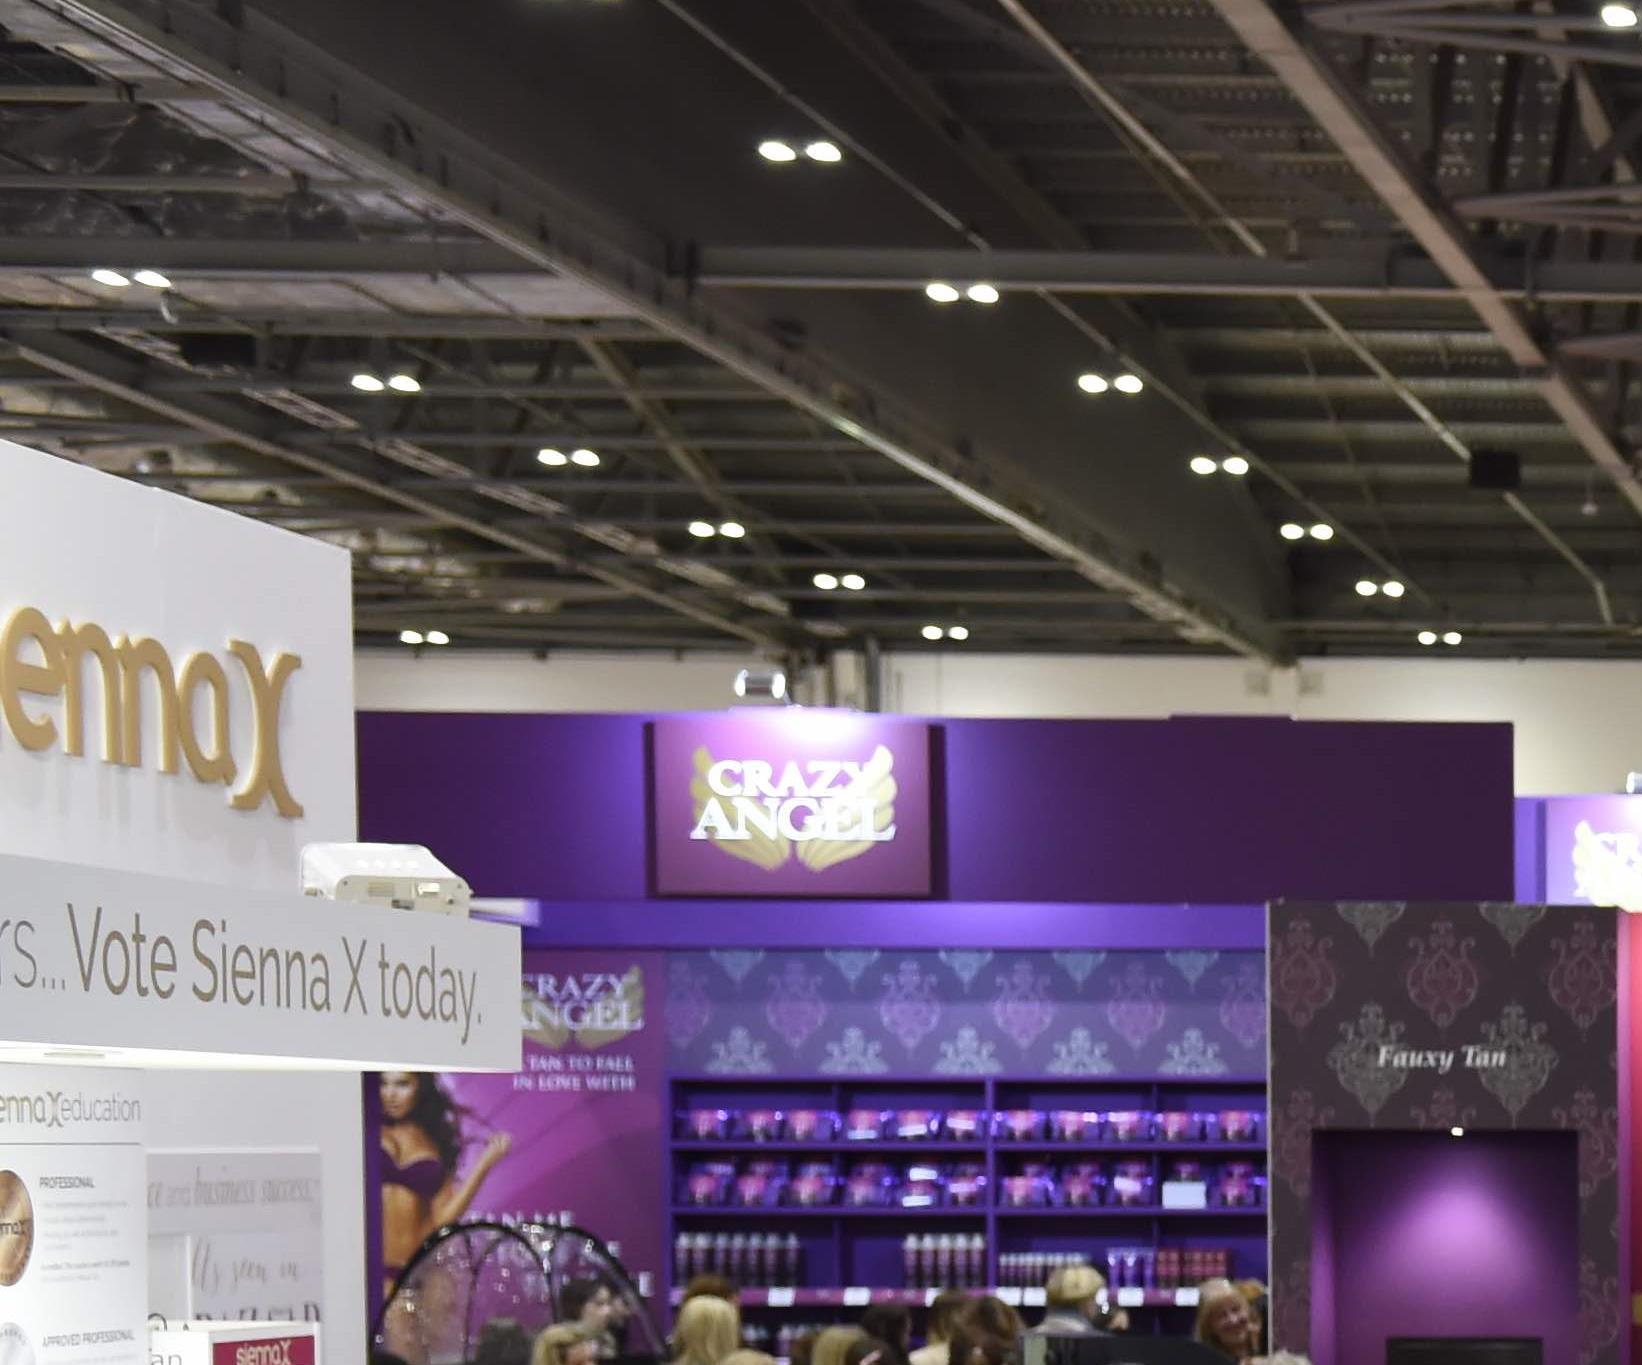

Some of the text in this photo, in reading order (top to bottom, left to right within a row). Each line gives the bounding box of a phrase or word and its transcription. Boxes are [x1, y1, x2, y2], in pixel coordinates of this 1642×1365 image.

[707, 760, 878, 798] CRAZY
[690, 797, 896, 841] ANGEL
[191, 918, 332, 1012] Sienna
[342, 936, 368, 1014] X
[379, 942, 482, 1045] today.
[1377, 1045, 1507, 1074] Fauxy Tan
[537, 1074, 582, 1092] LOVE
[39, 1176, 96, 1189] PROFESSIONAL
[83, 1328, 136, 1344] PROFESSIONAL
